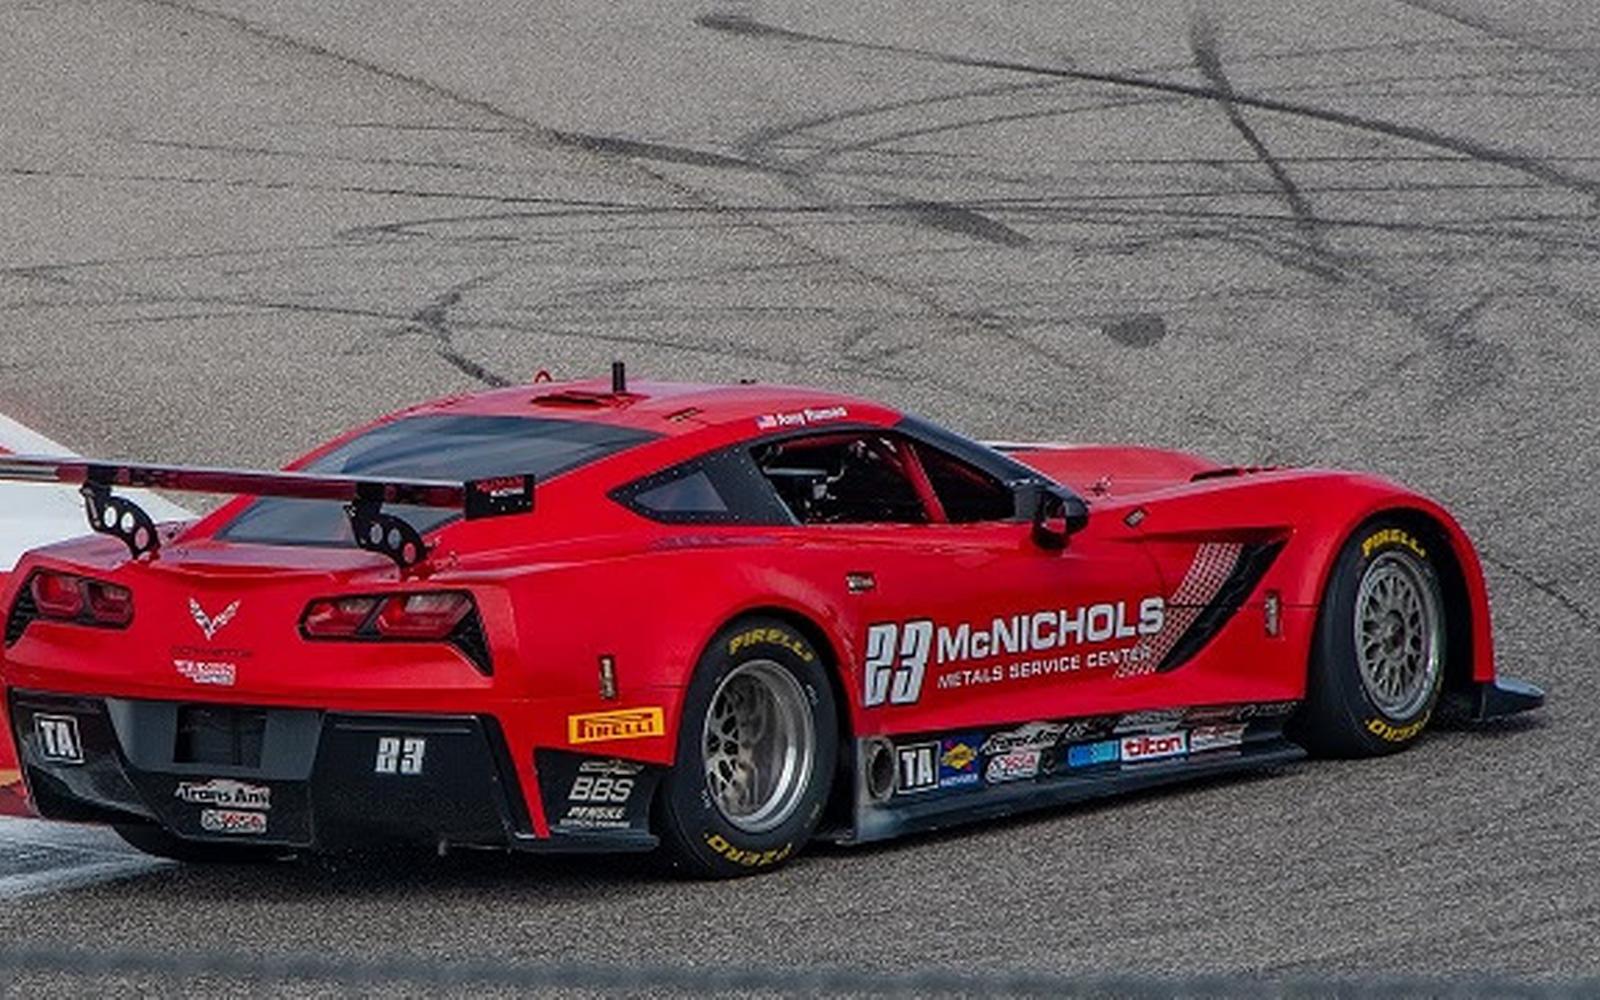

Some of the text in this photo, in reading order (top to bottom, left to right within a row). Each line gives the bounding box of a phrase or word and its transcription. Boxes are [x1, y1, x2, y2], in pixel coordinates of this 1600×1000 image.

[937, 597, 1164, 664] McNICHOLS
[865, 620, 934, 707] 23
[937, 667, 1003, 689] METALS
[1009, 655, 1080, 679] SERVICE
[40, 720, 77, 758] TA
[576, 711, 655, 739] PIRELLI
[375, 737, 426, 774] 23
[1124, 736, 1182, 757] tilton
[902, 749, 934, 788] TA
[568, 776, 635, 802] BBS
[567, 806, 625, 820] PENSKE
